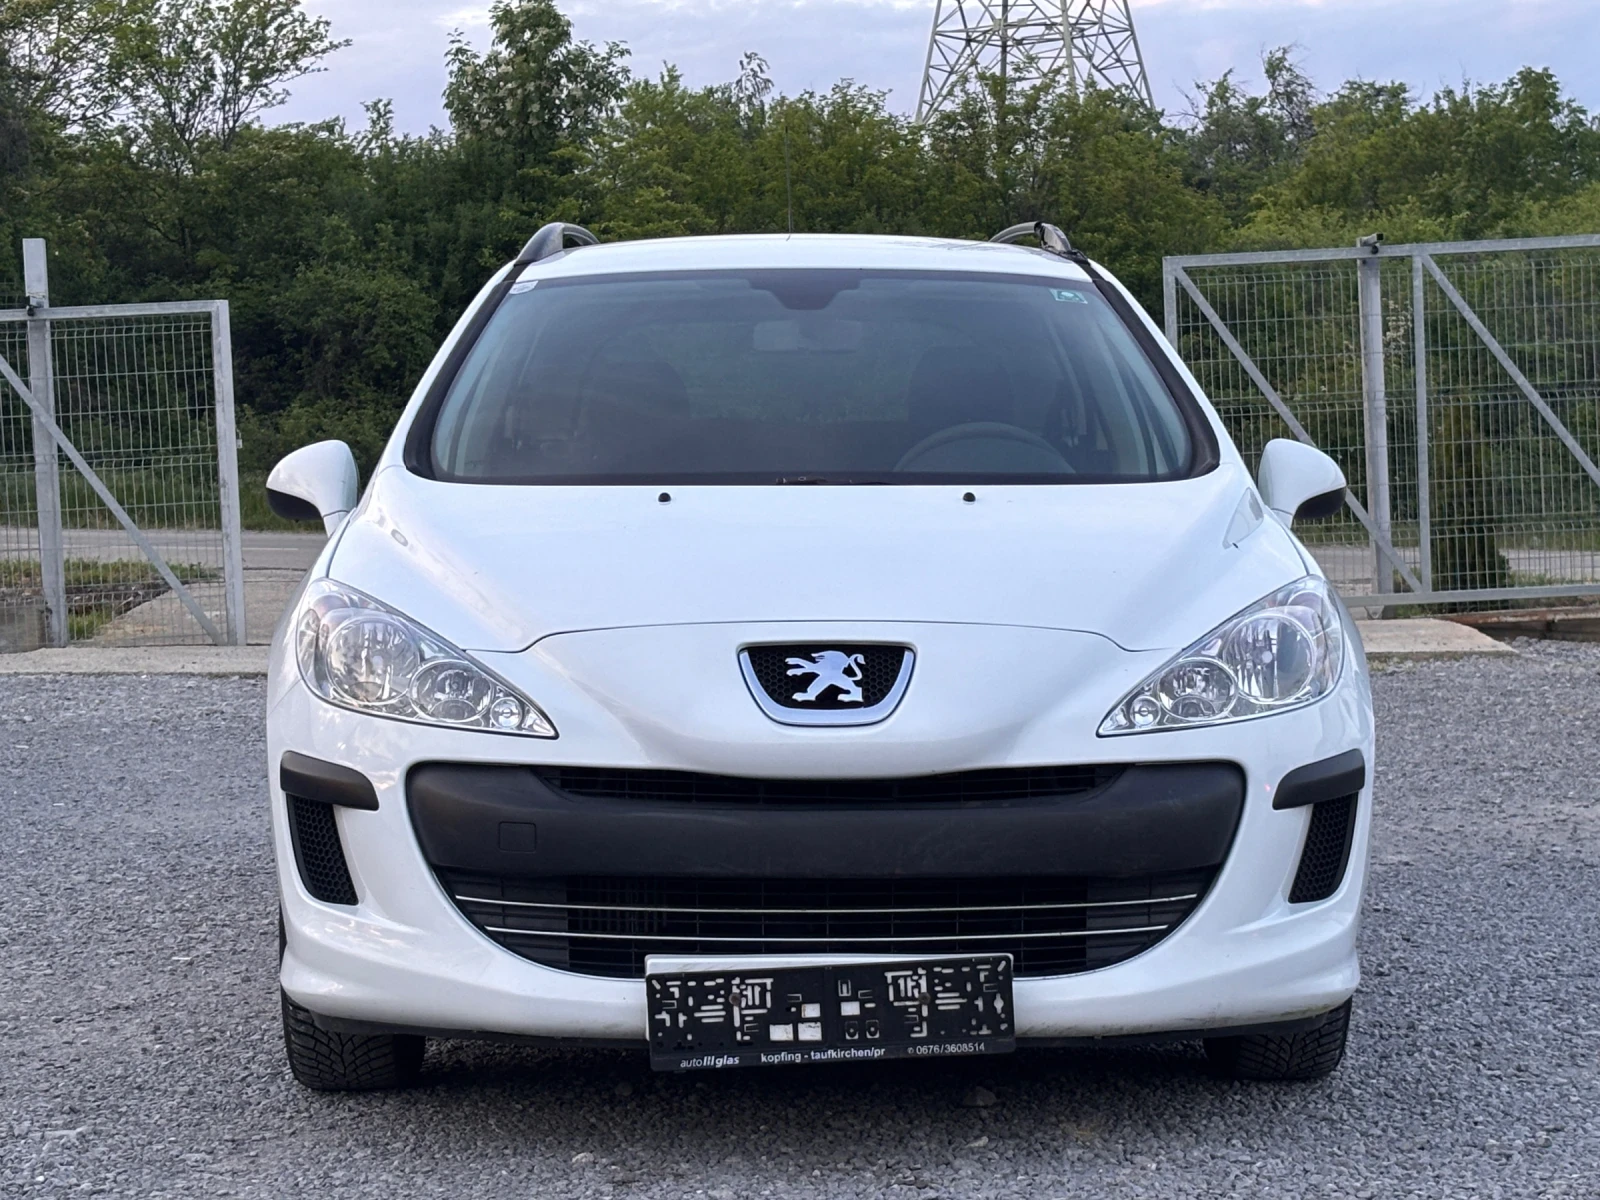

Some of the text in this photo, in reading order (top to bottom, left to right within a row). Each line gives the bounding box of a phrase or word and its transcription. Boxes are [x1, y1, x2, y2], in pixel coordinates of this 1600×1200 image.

[761, 1052, 801, 1063] kopfing
[810, 1047, 885, 1060] taufkirchen/pr
[916, 1042, 986, 1055] 0676/3608514
